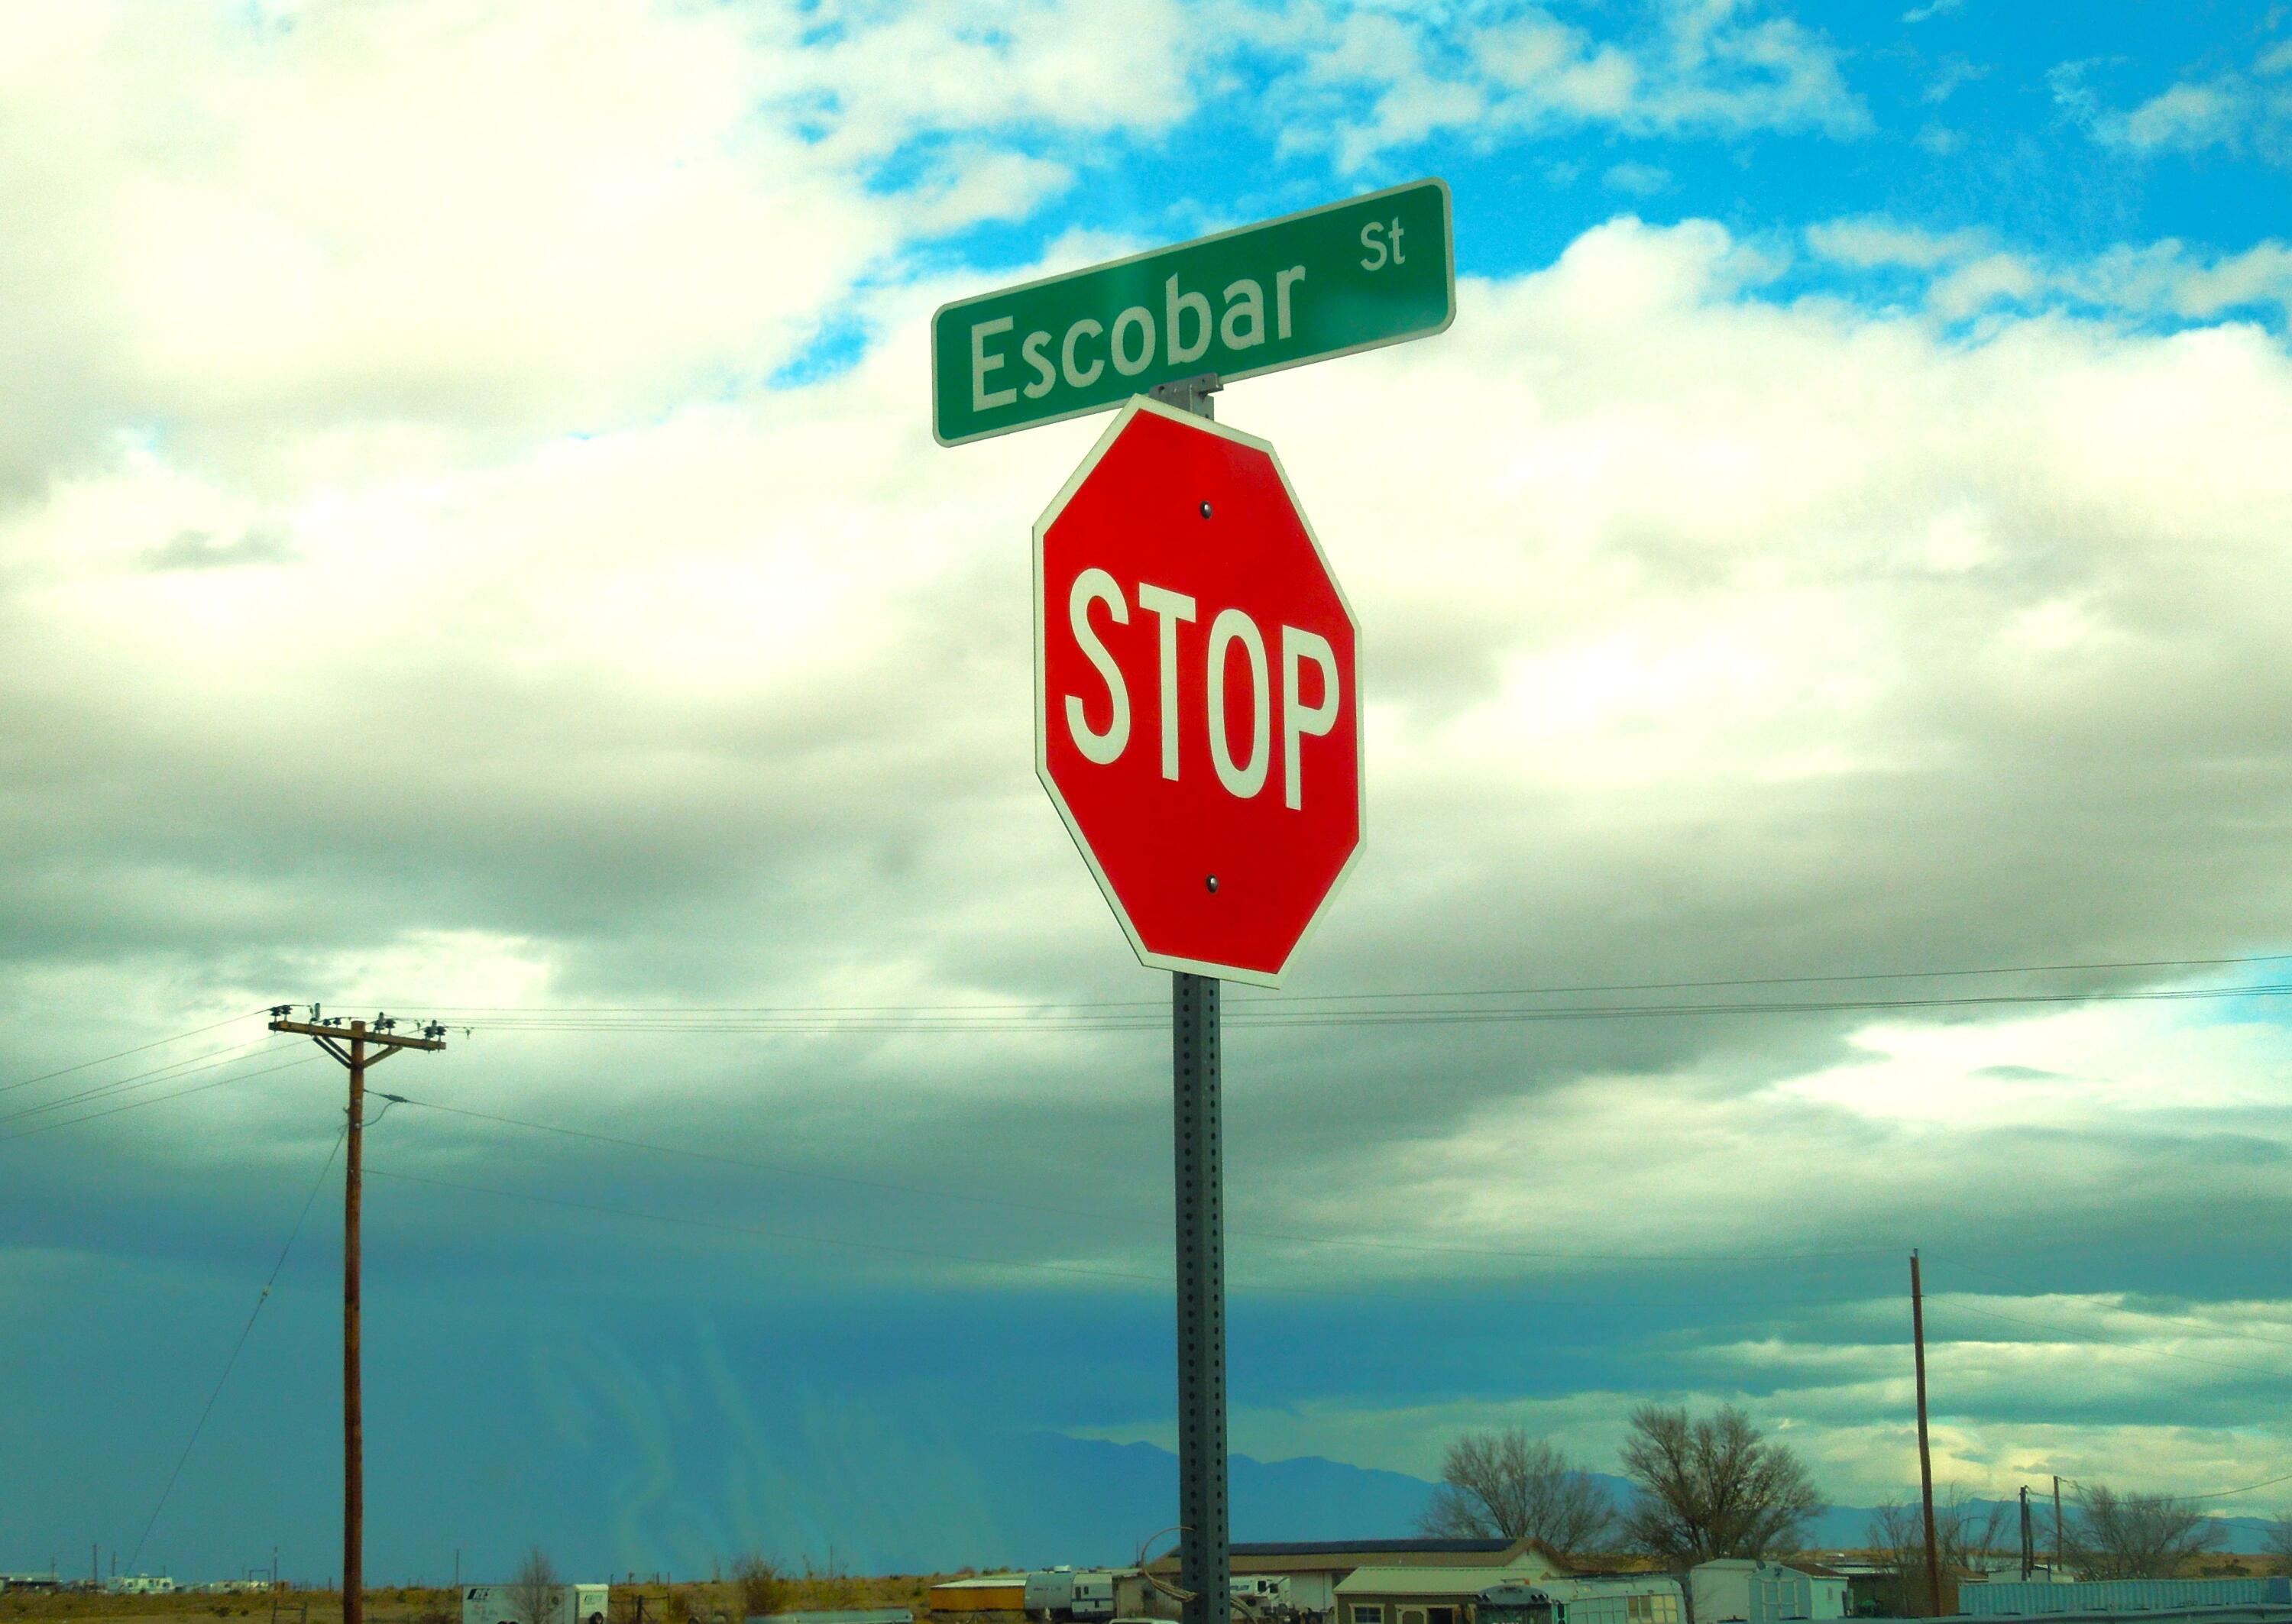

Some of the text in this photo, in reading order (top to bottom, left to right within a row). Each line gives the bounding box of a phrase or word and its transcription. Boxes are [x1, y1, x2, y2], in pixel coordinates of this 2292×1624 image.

[971, 216, 1407, 412] Escobar St
[1064, 568, 1341, 811] STOP
